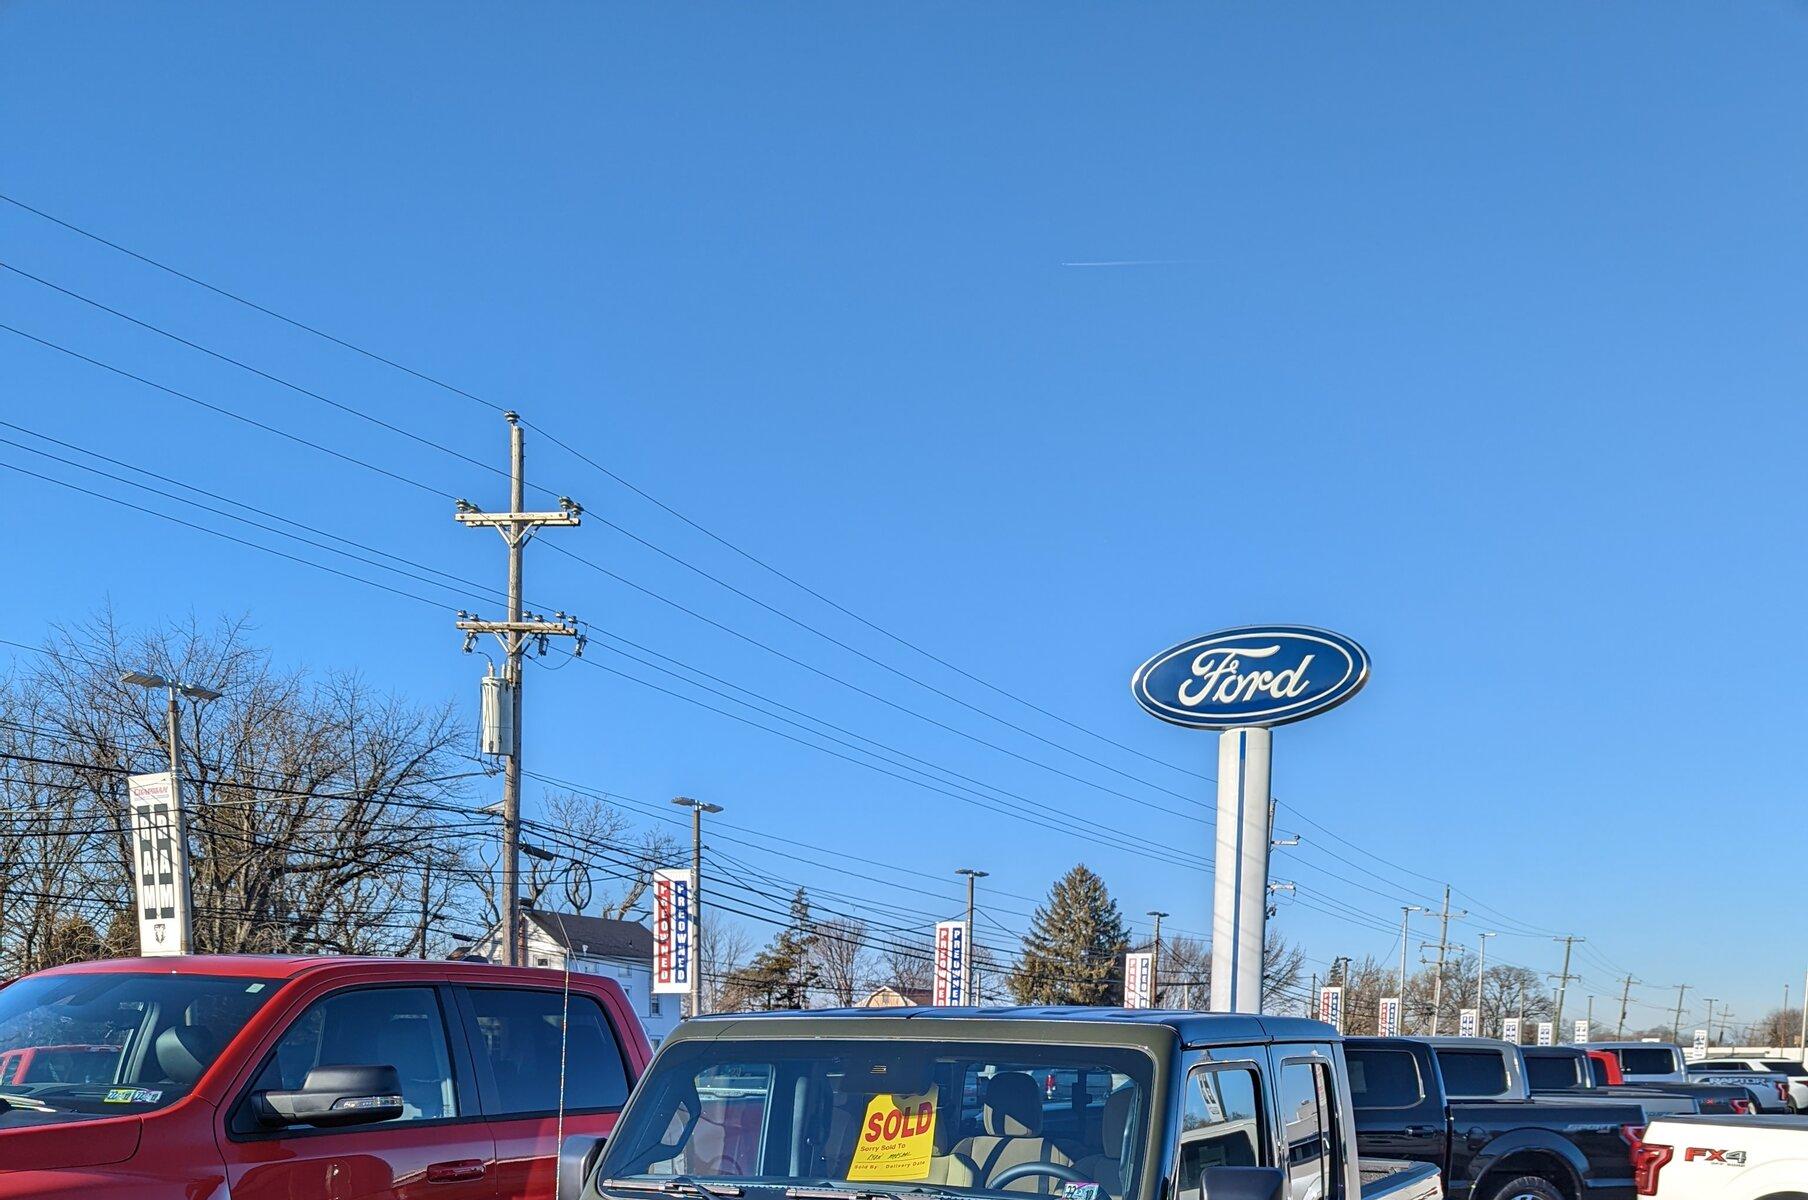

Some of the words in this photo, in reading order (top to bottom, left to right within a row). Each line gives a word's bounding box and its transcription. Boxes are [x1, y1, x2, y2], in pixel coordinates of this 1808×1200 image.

[1178, 645, 1315, 707] Ford
[139, 815, 156, 909] RAM
[156, 814, 174, 908] RAM
[1709, 1077, 1767, 1087] RAPTOR
[865, 1101, 932, 1142] SOLD
[1684, 1147, 1747, 1164] FX4
